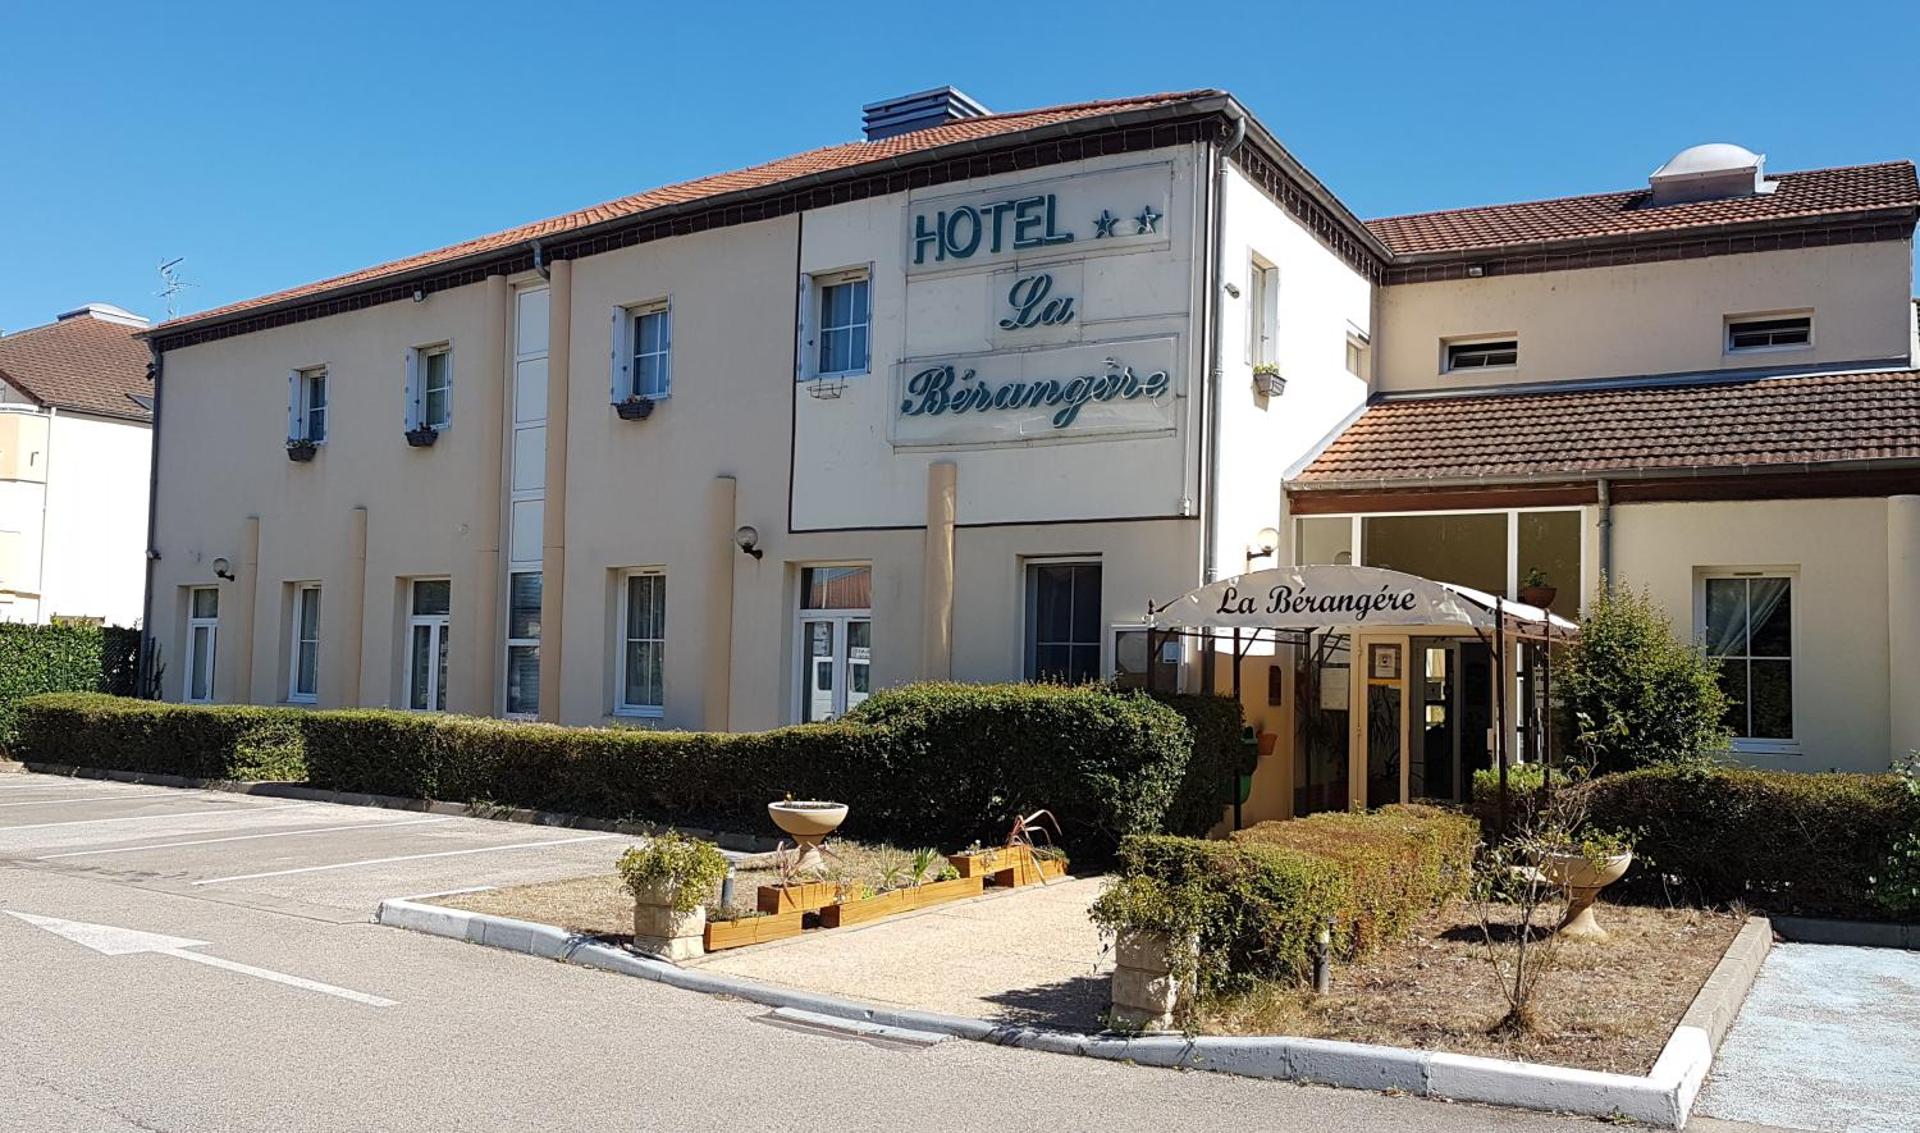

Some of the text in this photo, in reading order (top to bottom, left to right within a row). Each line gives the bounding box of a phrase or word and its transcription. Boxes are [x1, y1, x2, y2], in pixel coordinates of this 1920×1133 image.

[913, 194, 1075, 264] HOTEL
[999, 273, 1075, 330] La
[1216, 586, 1257, 614] La
